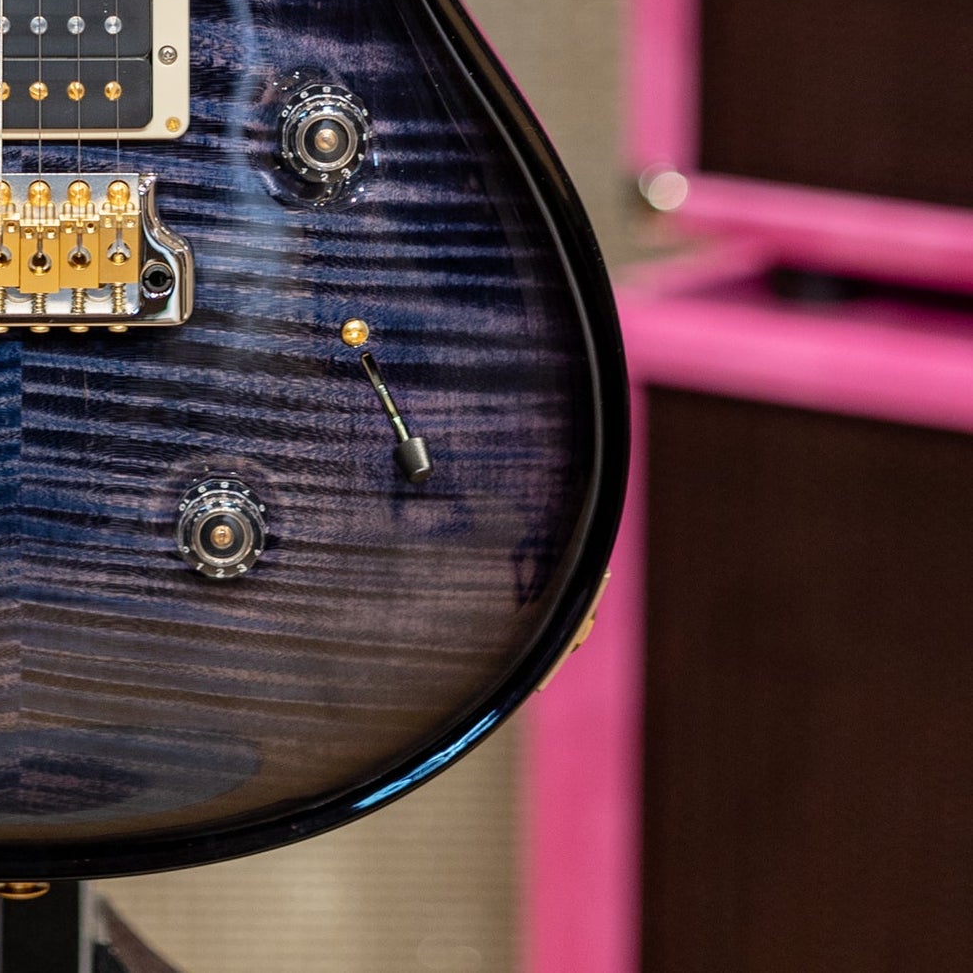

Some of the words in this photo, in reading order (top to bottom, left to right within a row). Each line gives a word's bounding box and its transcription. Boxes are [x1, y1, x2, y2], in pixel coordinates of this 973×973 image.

[320, 173, 330, 183] 2
[341, 168, 352, 179] 3
[196, 562, 205, 571] 1
[216, 568, 226, 579] 2
[236, 563, 247, 573] 3
